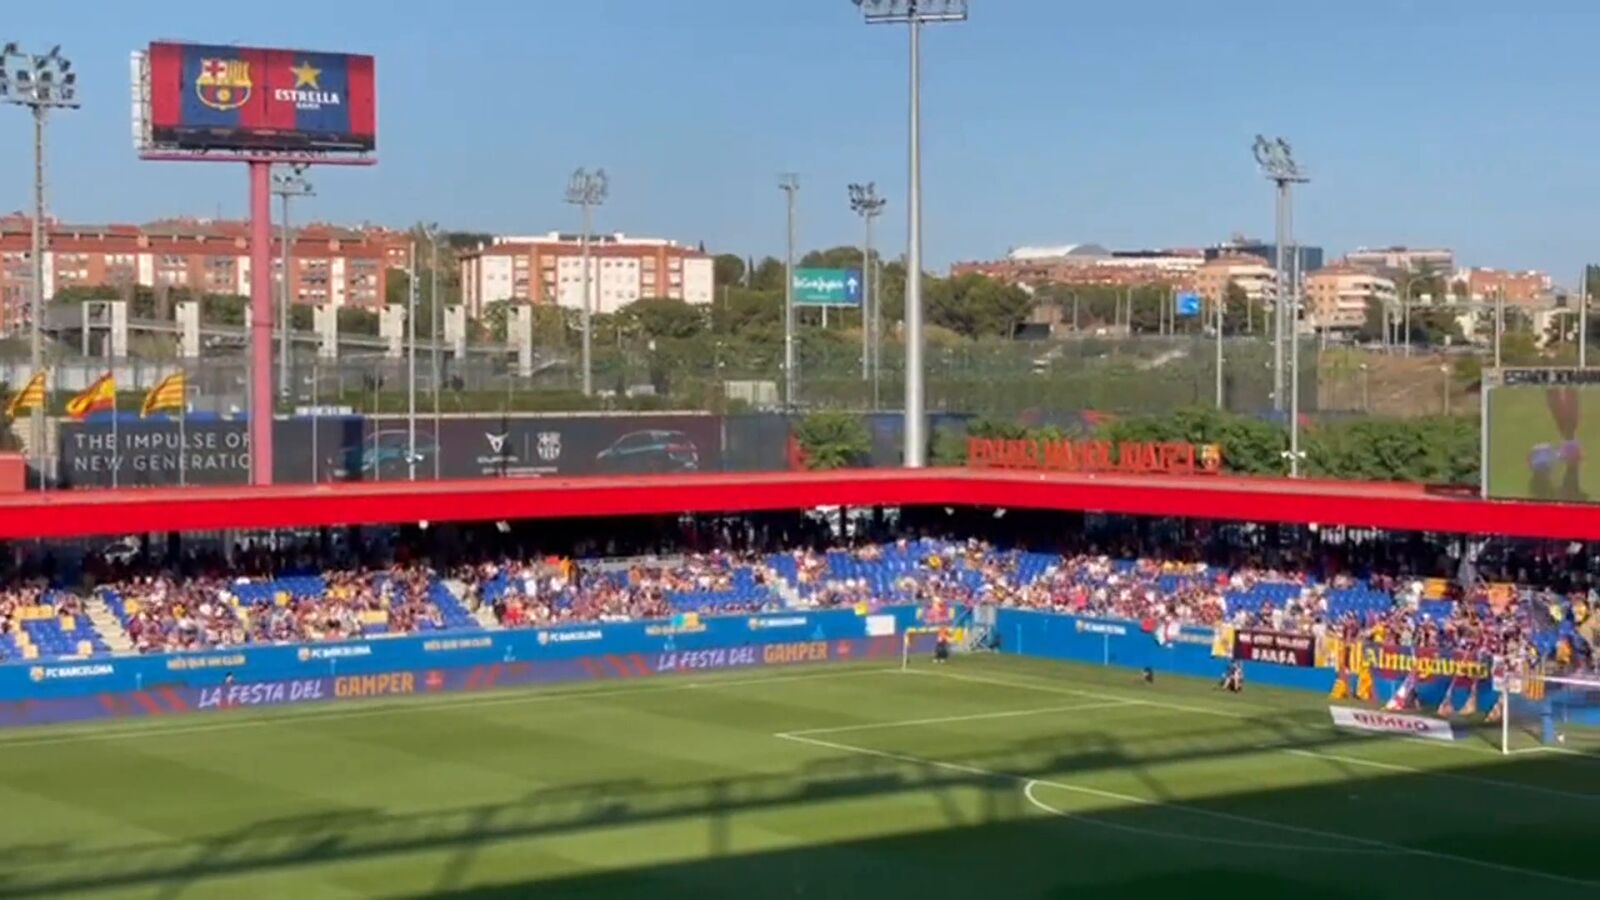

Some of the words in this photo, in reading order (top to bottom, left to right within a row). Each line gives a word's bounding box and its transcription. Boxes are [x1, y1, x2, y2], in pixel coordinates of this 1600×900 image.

[275, 88, 340, 105] ESTRELLA
[75, 433, 115, 450] THE
[126, 432, 217, 449] IMPULSE
[74, 455, 123, 472] NEW
[132, 453, 251, 471] GENERATIO
[657, 653, 675, 671] LA
[680, 648, 725, 669] FESTA
[728, 647, 756, 664] DEL
[763, 641, 828, 664] GAMPER
[59, 664, 114, 677] BARCELONA
[198, 688, 220, 708] LA
[228, 682, 285, 706] FESTA
[290, 679, 323, 701] DEL
[334, 672, 415, 697] GAMPER
